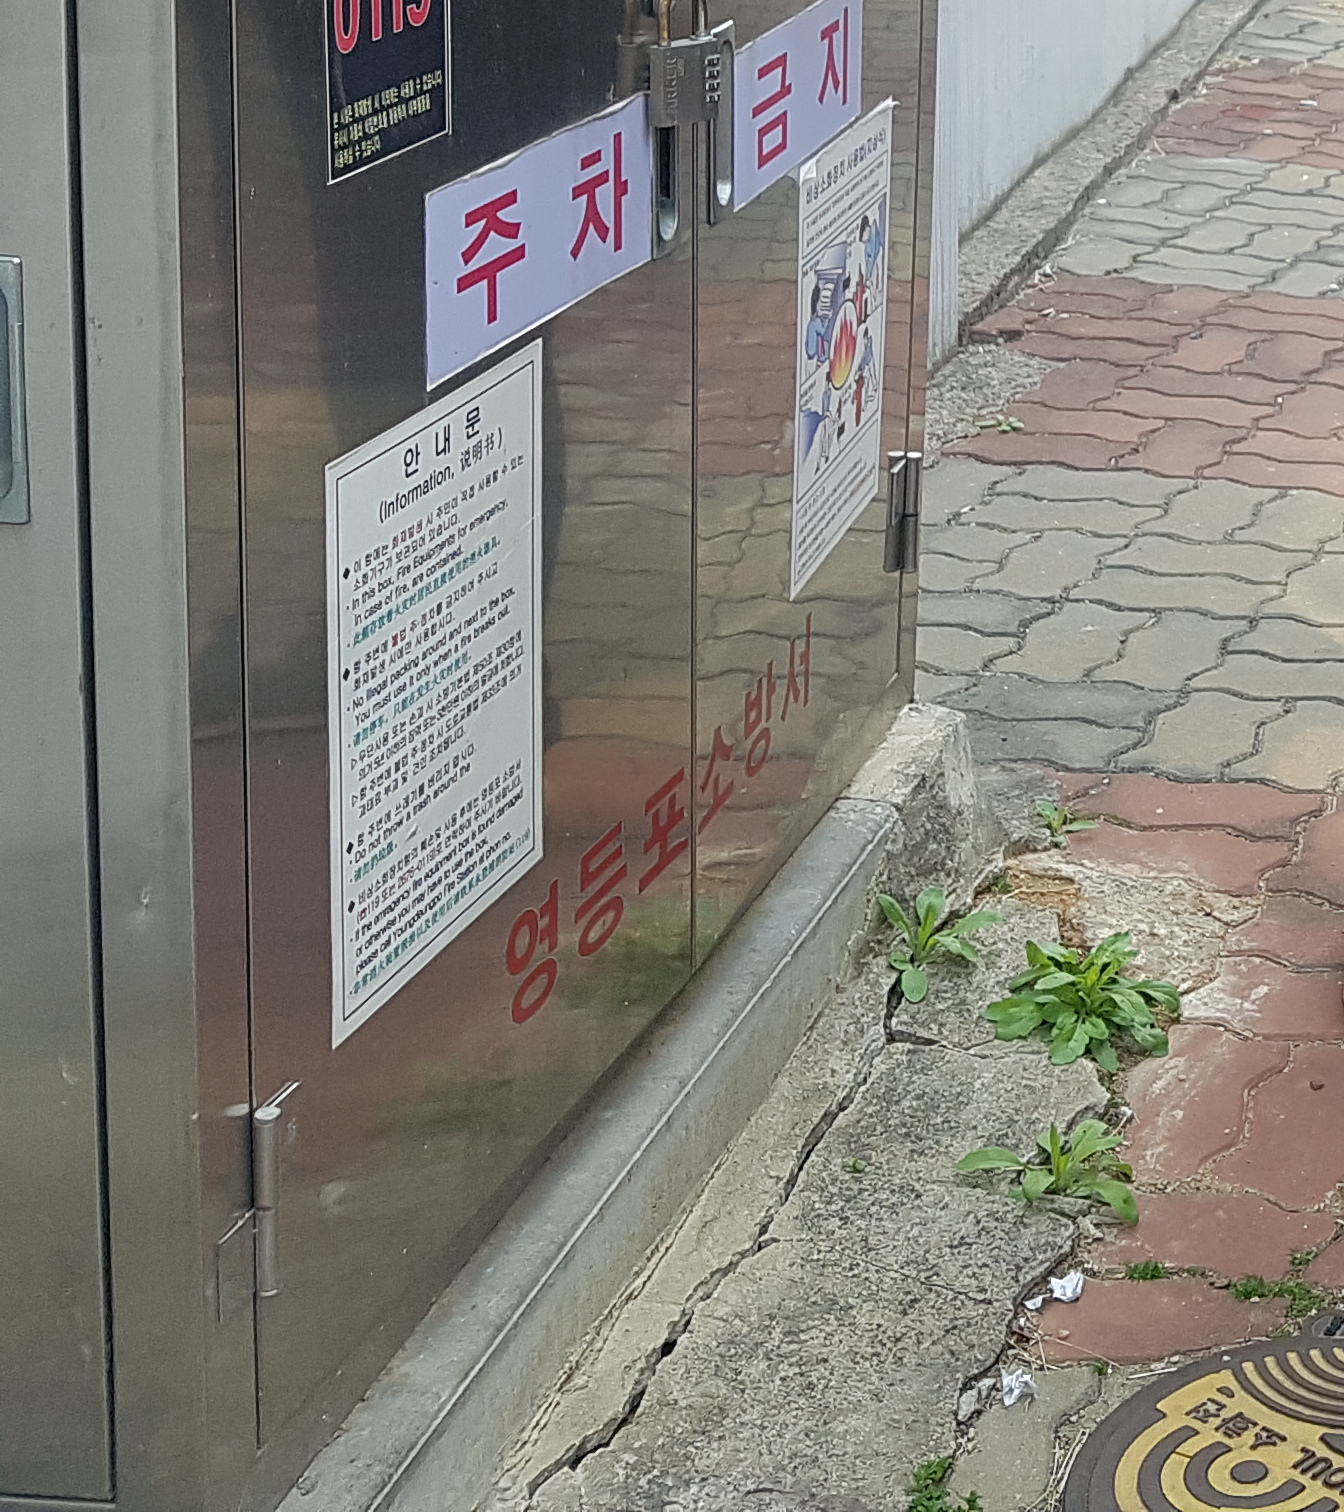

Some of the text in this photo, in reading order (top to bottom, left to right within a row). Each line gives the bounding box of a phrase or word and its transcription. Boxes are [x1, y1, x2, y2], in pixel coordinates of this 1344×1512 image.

[751, 6, 848, 170] 금지
[378, 457, 454, 524] (Information,
[362, 586, 375, 605] this
[396, 561, 411, 581] Fire
[457, 523, 467, 539] for
[363, 597, 382, 621] case
[384, 591, 392, 606] of
[411, 569, 424, 587] are
[353, 693, 363, 711] No
[448, 621, 461, 641] and
[463, 609, 478, 629] next
[488, 593, 499, 611] the
[355, 706, 370, 727] You
[373, 690, 391, 714] must
[393, 679, 406, 698] use
[415, 660, 431, 682] only
[432, 644, 452, 669] when
[473, 612, 496, 638] breaks
[354, 845, 366, 863] Do
[368, 833, 380, 852] not
[382, 813, 404, 840] throw
[505, 611, 812, 1024] 영등포소방서
[361, 918, 372, 936] the
[398, 902, 410, 921] you
